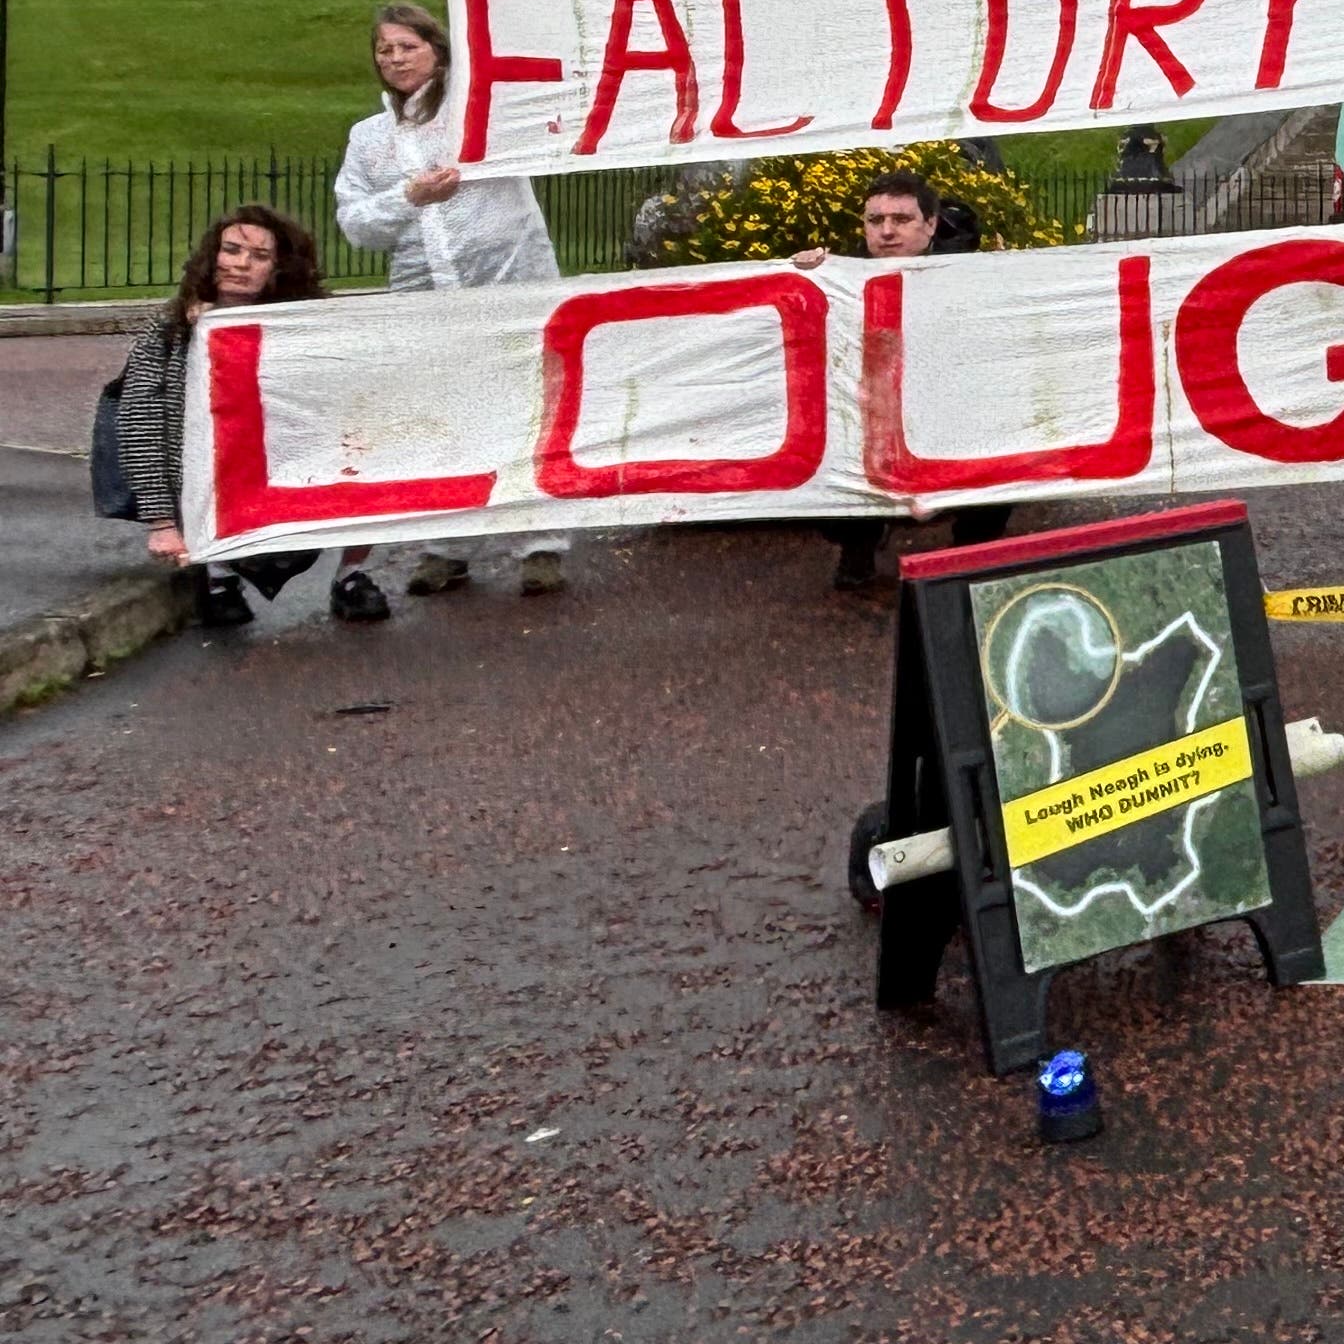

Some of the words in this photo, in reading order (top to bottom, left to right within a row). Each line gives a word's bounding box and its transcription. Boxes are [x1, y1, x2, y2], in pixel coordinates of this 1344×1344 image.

[1024, 792, 1085, 825] Lough
[1089, 767, 1150, 801] Neagh
[1154, 761, 1170, 776] is
[1175, 741, 1230, 769] dying.
[1066, 805, 1113, 834] WHO
[1119, 770, 1200, 815] DUNNIT?
